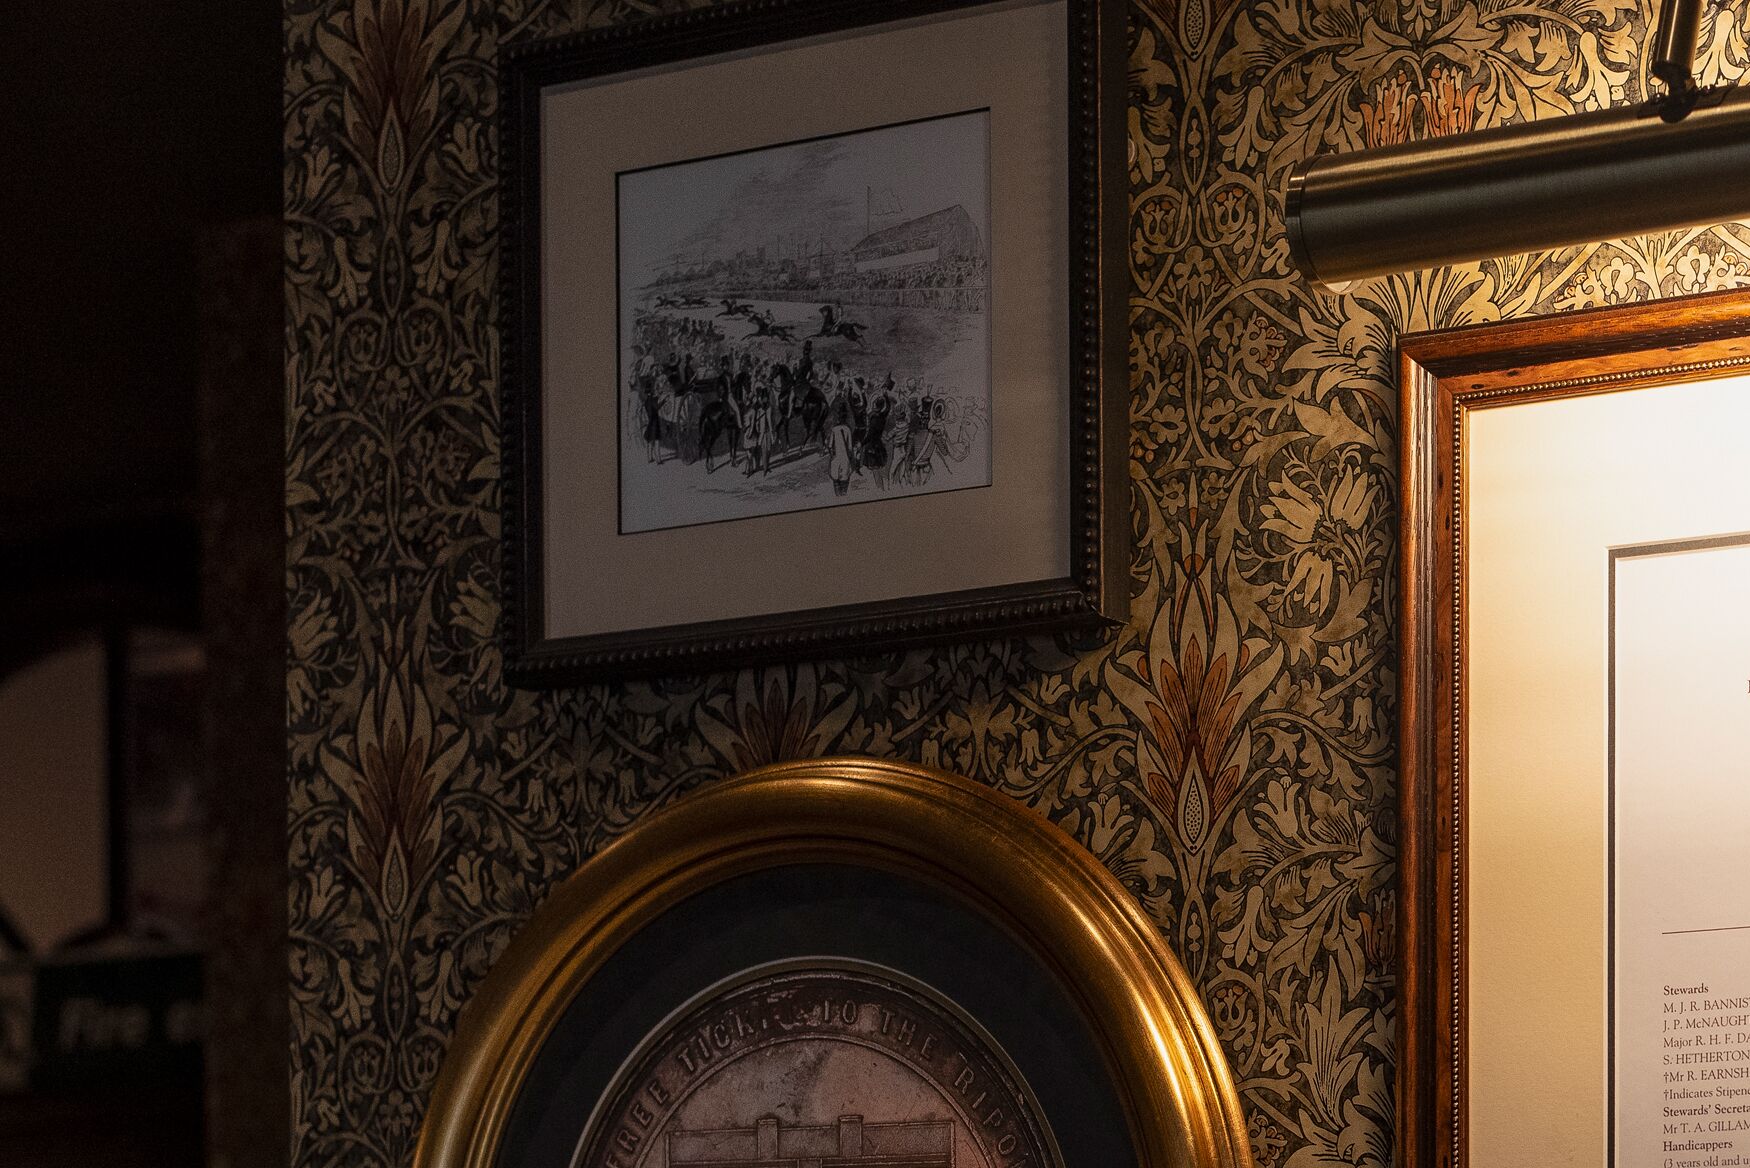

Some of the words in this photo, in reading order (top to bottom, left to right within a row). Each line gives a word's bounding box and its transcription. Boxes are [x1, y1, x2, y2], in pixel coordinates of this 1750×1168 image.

[1663, 982, 1708, 995] Stewards
[1663, 1002, 1676, 1013] M.
[1679, 1001, 1686, 1014] J.
[1689, 1000, 1700, 1011] R.
[881, 1008, 939, 1063] THE
[1662, 1104, 1711, 1117] Stewards'
[1662, 1139, 1732, 1152] Handicappers
[1702, 1155, 1718, 1167] old
[1721, 1154, 1740, 1166] and
